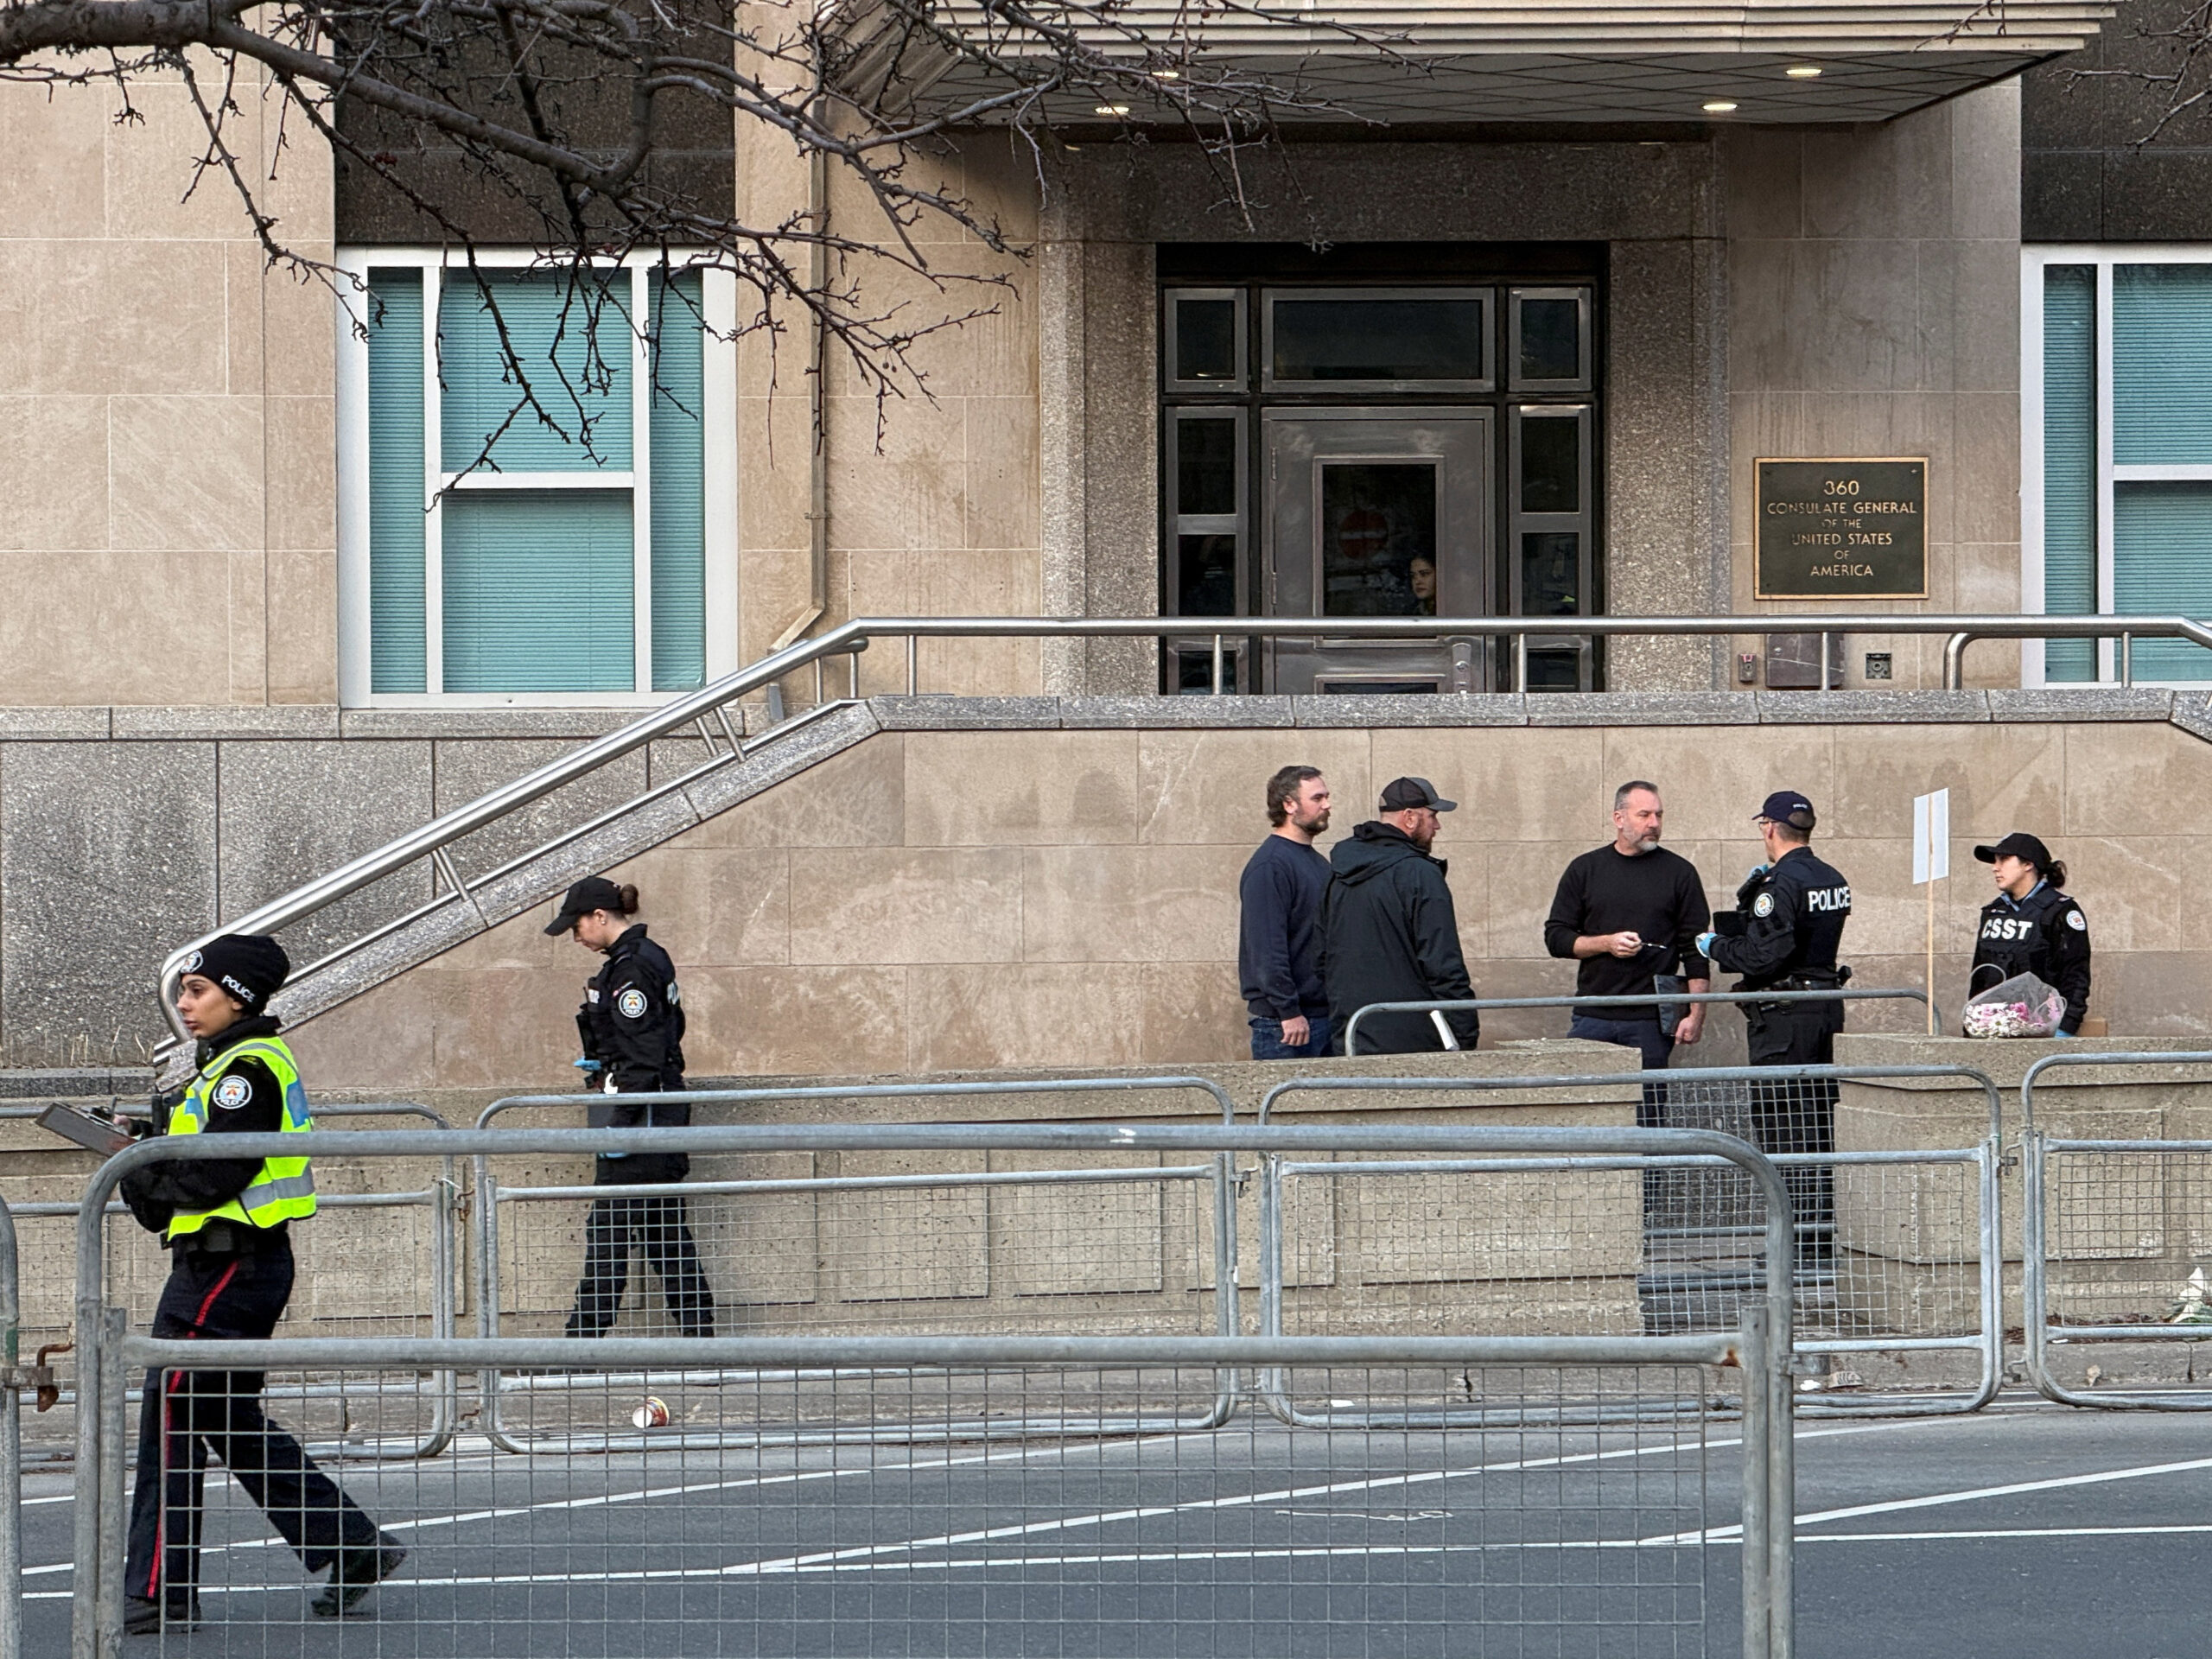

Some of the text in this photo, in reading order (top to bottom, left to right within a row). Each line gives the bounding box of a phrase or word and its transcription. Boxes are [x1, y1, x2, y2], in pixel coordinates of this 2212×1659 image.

[1823, 480, 1859, 495] 360
[1767, 502, 1916, 514] CONSULATE GENERAL
[1821, 519, 1861, 529] OF THE
[1792, 533, 1892, 545] UNITED STATES
[1834, 550, 1849, 560] OF
[1810, 564, 1873, 576] AMERICA
[1808, 887, 1851, 912] POLICE
[1981, 918, 2033, 939] CSST
[221, 975, 256, 1002] POLICE
